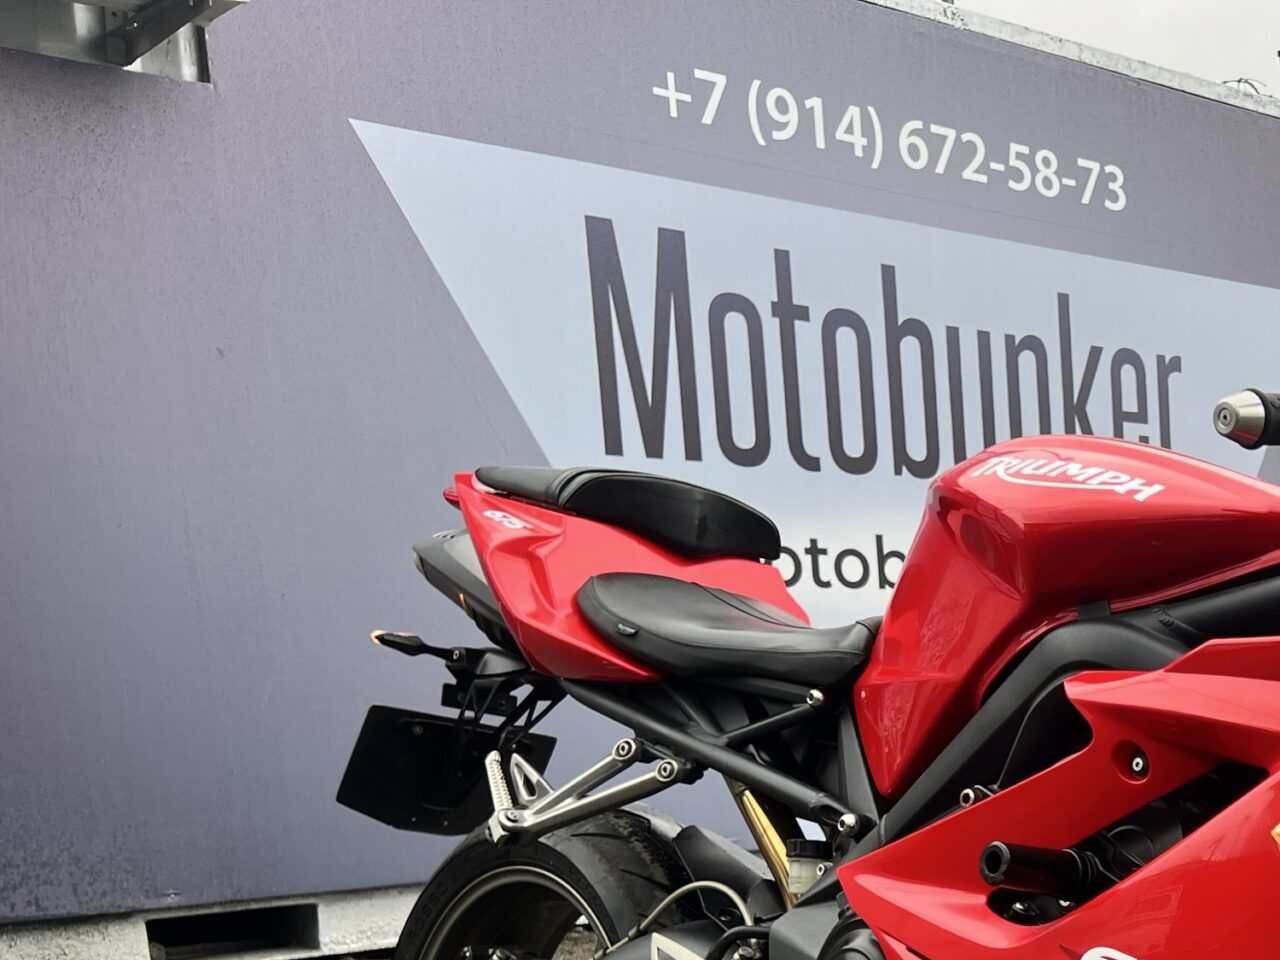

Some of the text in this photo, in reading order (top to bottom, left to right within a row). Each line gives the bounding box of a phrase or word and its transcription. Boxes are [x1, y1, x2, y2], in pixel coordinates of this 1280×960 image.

[652, 69, 1127, 211] +7 (914) 672-58-73
[584, 215, 1181, 479] Motobunker
[971, 455, 1165, 502] TRIUMPH
